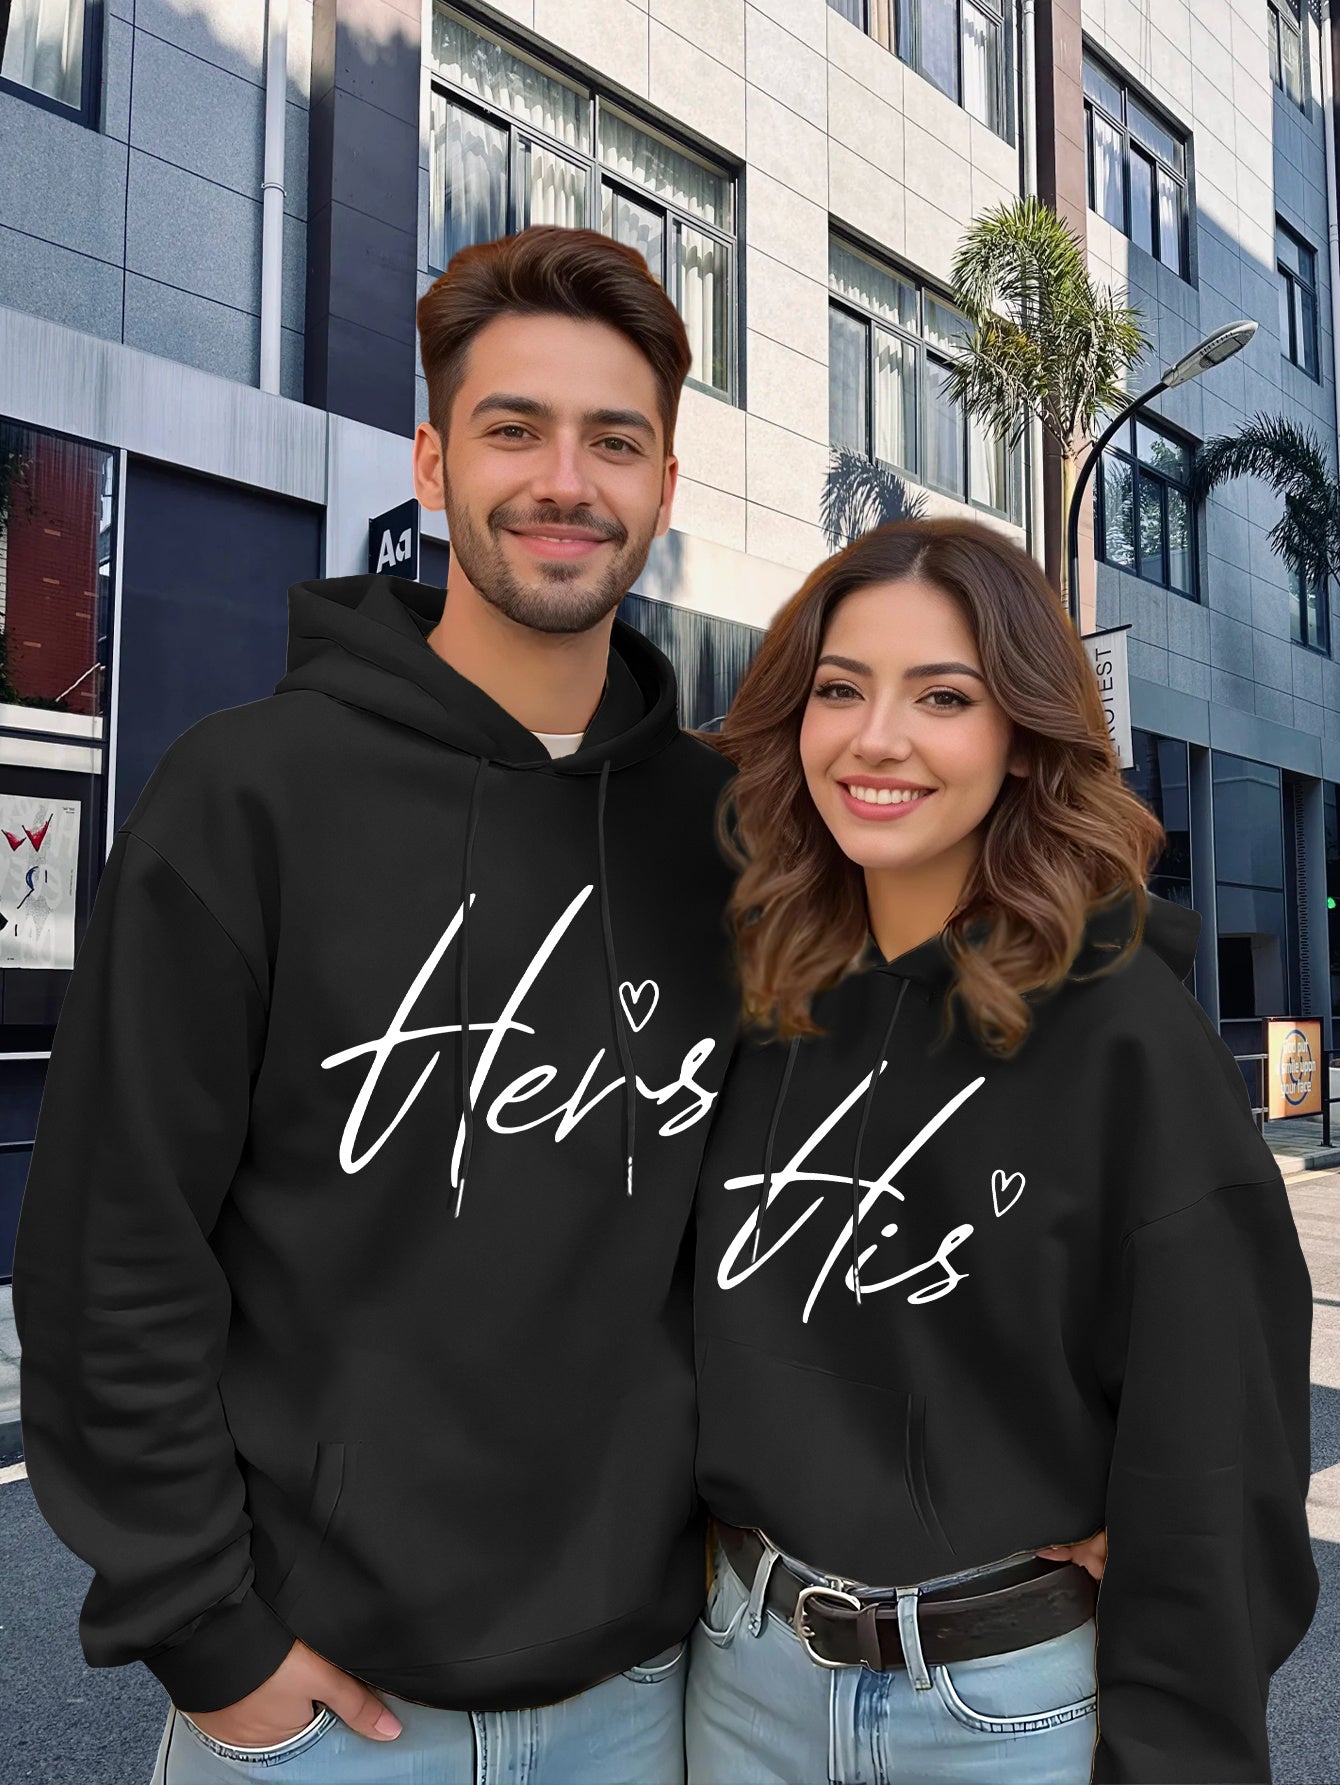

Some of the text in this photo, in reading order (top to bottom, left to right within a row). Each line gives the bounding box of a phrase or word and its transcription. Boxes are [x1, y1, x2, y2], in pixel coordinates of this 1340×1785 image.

[376, 528, 412, 574] Aa
[321, 885, 718, 1189] Hers
[717, 1060, 986, 1324] His
